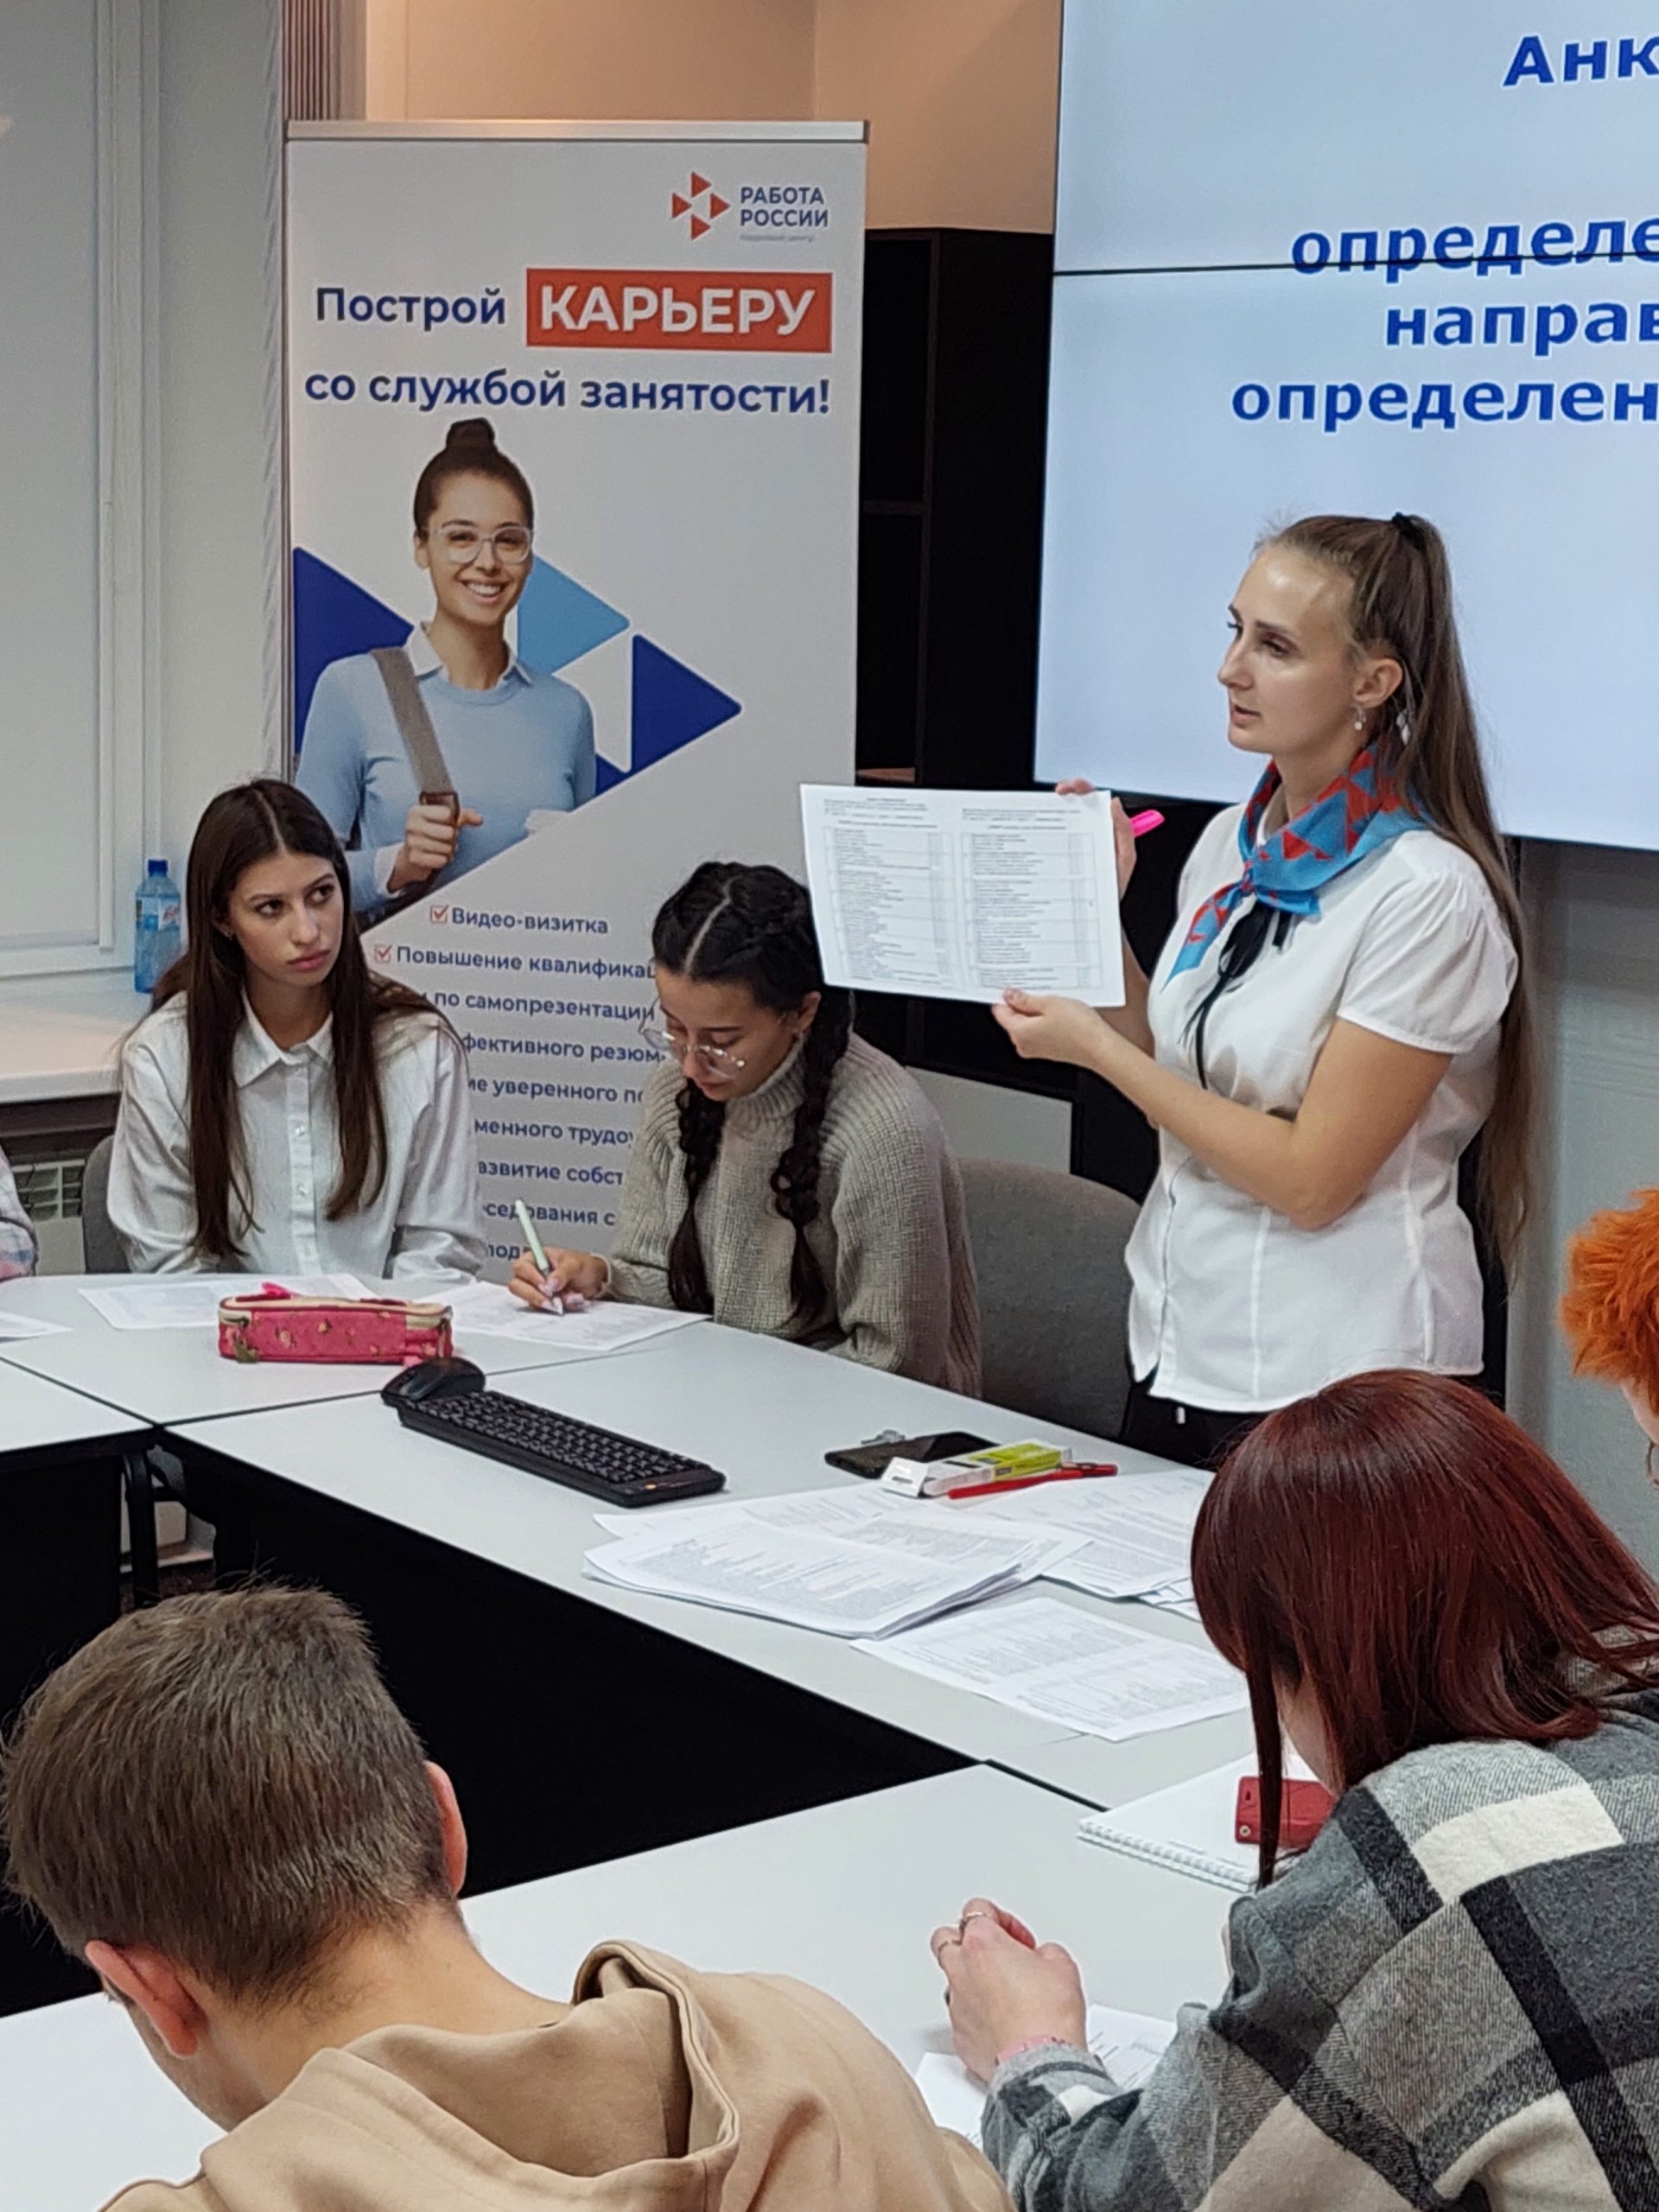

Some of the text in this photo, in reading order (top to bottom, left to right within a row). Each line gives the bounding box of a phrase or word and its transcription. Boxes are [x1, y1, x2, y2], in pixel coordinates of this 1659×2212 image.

[741, 186, 824, 205] РАБОТА
[741, 208, 829, 227] РОССИИ
[1292, 218, 1659, 284] определе
[316, 284, 816, 336] Построй КАРЬЕРУ
[305, 369, 830, 414] со службой занятости!
[1232, 382, 1659, 433] определен
[452, 907, 608, 935] Видео-визитка
[397, 946, 523, 970] Повышение
[434, 992, 461, 1007] по
[465, 994, 655, 1022] самопрезентации
[493, 1079, 619, 1102] уверенного
